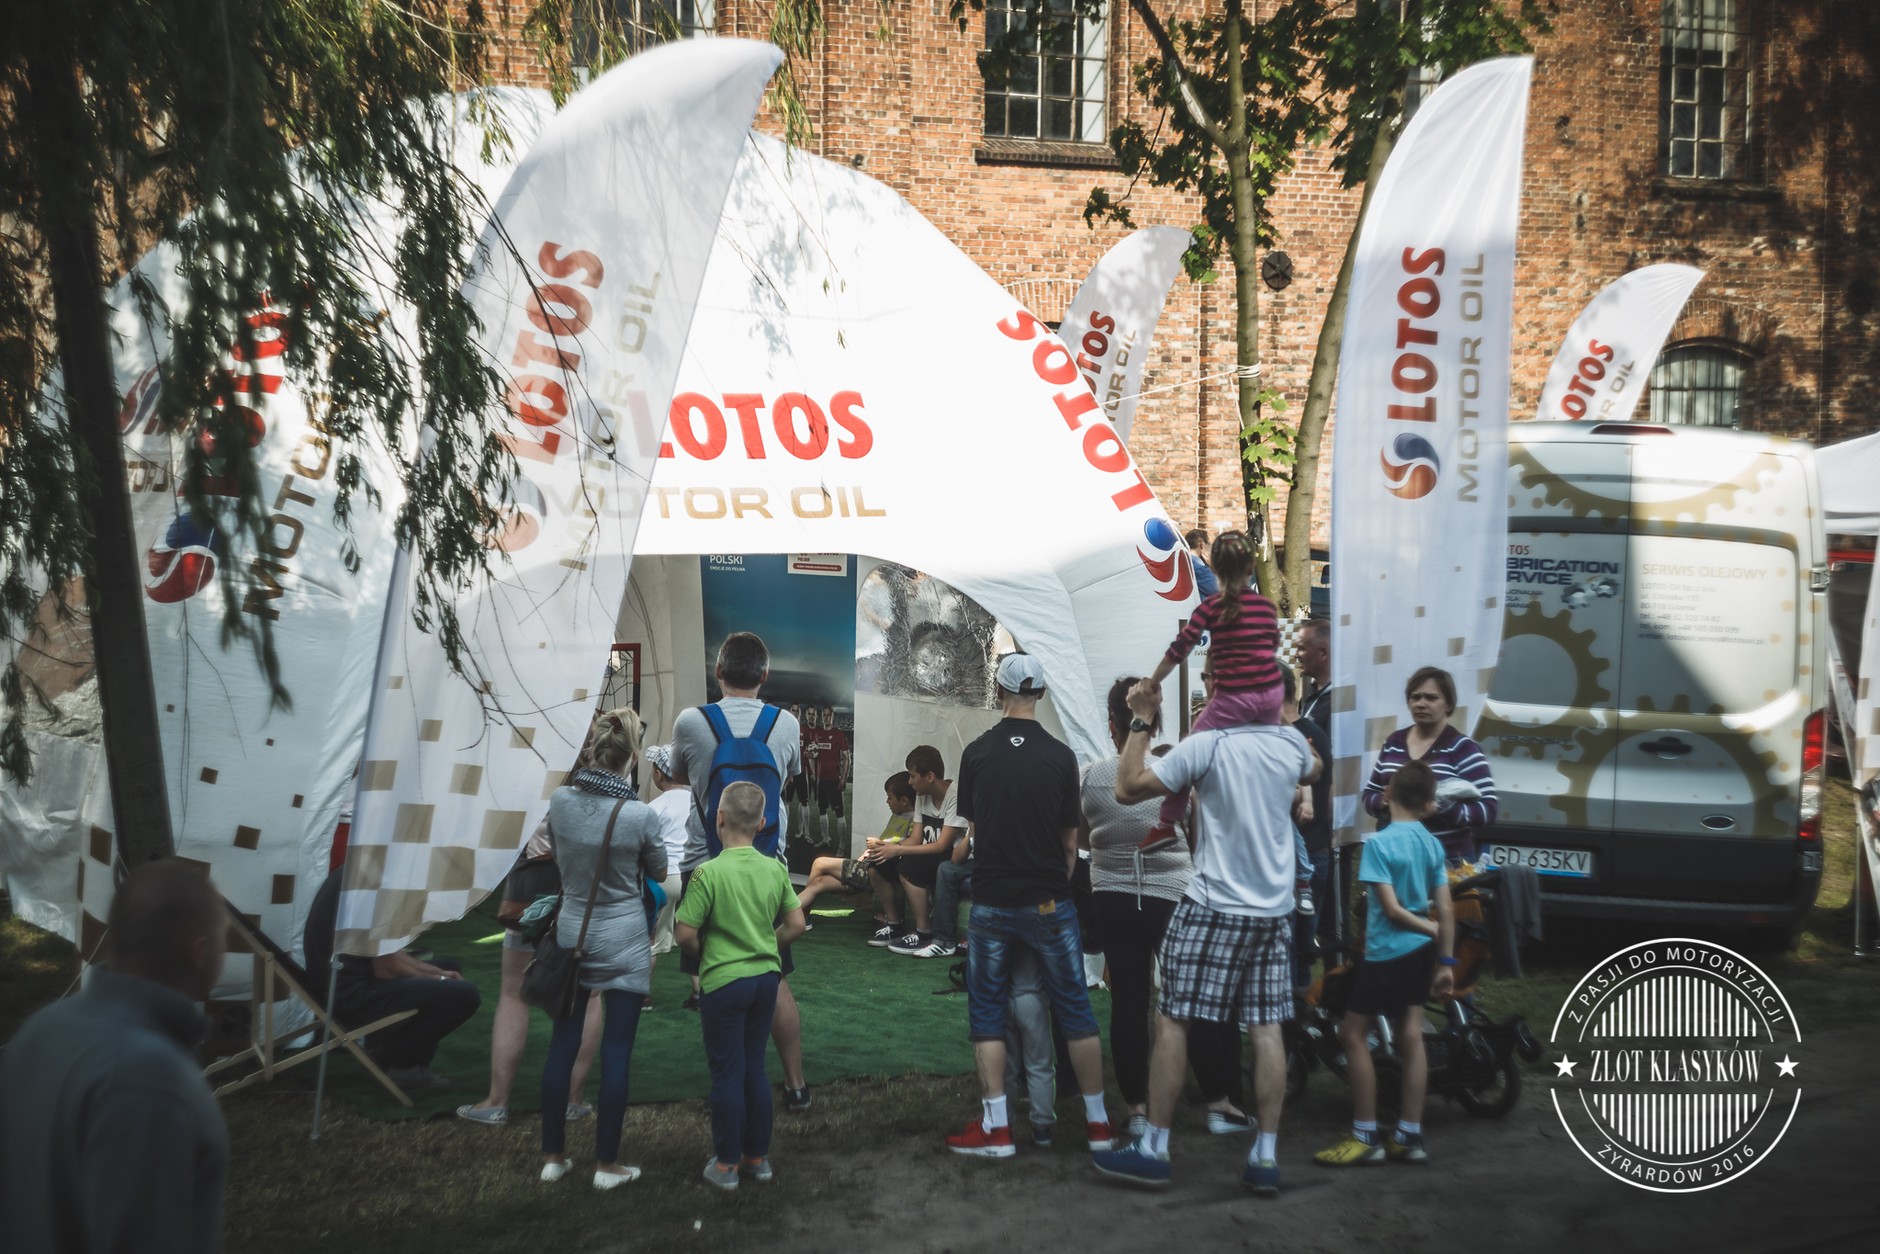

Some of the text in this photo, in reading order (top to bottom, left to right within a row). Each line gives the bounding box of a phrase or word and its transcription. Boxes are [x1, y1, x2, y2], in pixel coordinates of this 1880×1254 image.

[1115, 330, 1136, 367] OIL
[1387, 246, 1446, 423] LOTOS
[496, 241, 604, 465] LOTOS
[1076, 310, 1116, 395] TOS
[1457, 253, 1485, 503] MOTOR OIL
[1560, 339, 1614, 420] OTOS
[1609, 360, 1635, 393] OIL
[559, 271, 662, 571] MOTOR OIL
[996, 309, 1156, 513] LOTOS
[791, 486, 887, 518] OIL
[709, 554, 743, 565] POLSKI
[1506, 557, 1619, 574] BRICATION
[1509, 545, 1530, 555] TOS
[1506, 570, 1572, 585] RVICE
[1642, 563, 1768, 580] SERWIS OLEJOWY
[1493, 847, 1587, 871] GD 635KV
